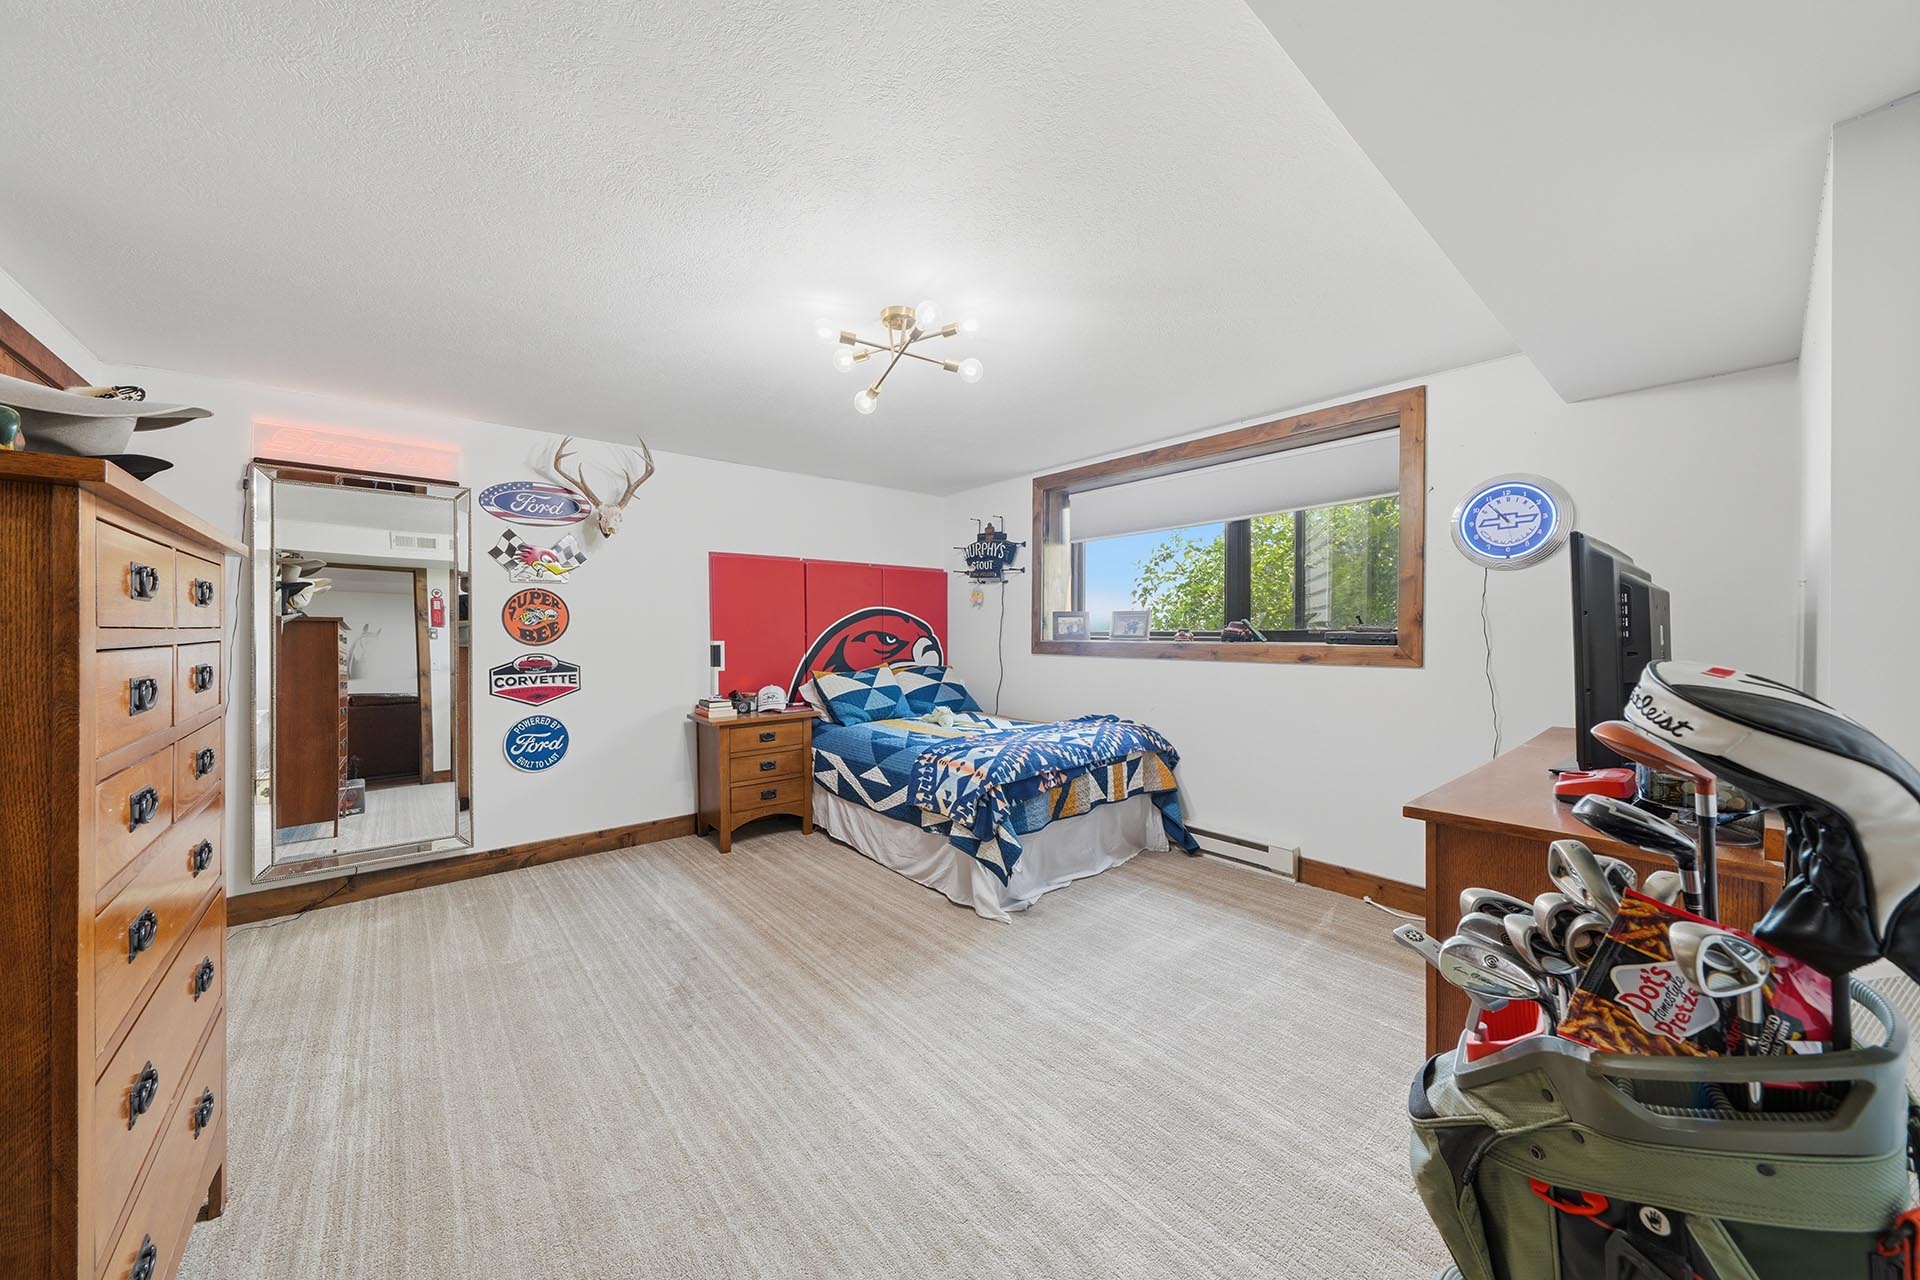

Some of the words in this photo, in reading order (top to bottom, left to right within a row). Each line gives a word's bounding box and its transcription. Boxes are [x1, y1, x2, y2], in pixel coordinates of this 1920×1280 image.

[510, 492, 564, 515] Ford
[971, 560, 994, 571] STOUT
[508, 591, 561, 622] SUPER
[517, 621, 560, 642] BEE
[494, 674, 578, 688] CORVETTE
[513, 717, 550, 734] POWERED
[550, 722, 562, 731] BY
[510, 732, 565, 755] Ford
[515, 756, 534, 768] BUILT
[535, 760, 545, 768] TO
[545, 752, 561, 766] LAST
[1619, 965, 1672, 1014] Dot's
[1648, 975, 1688, 1023] Homestyle
